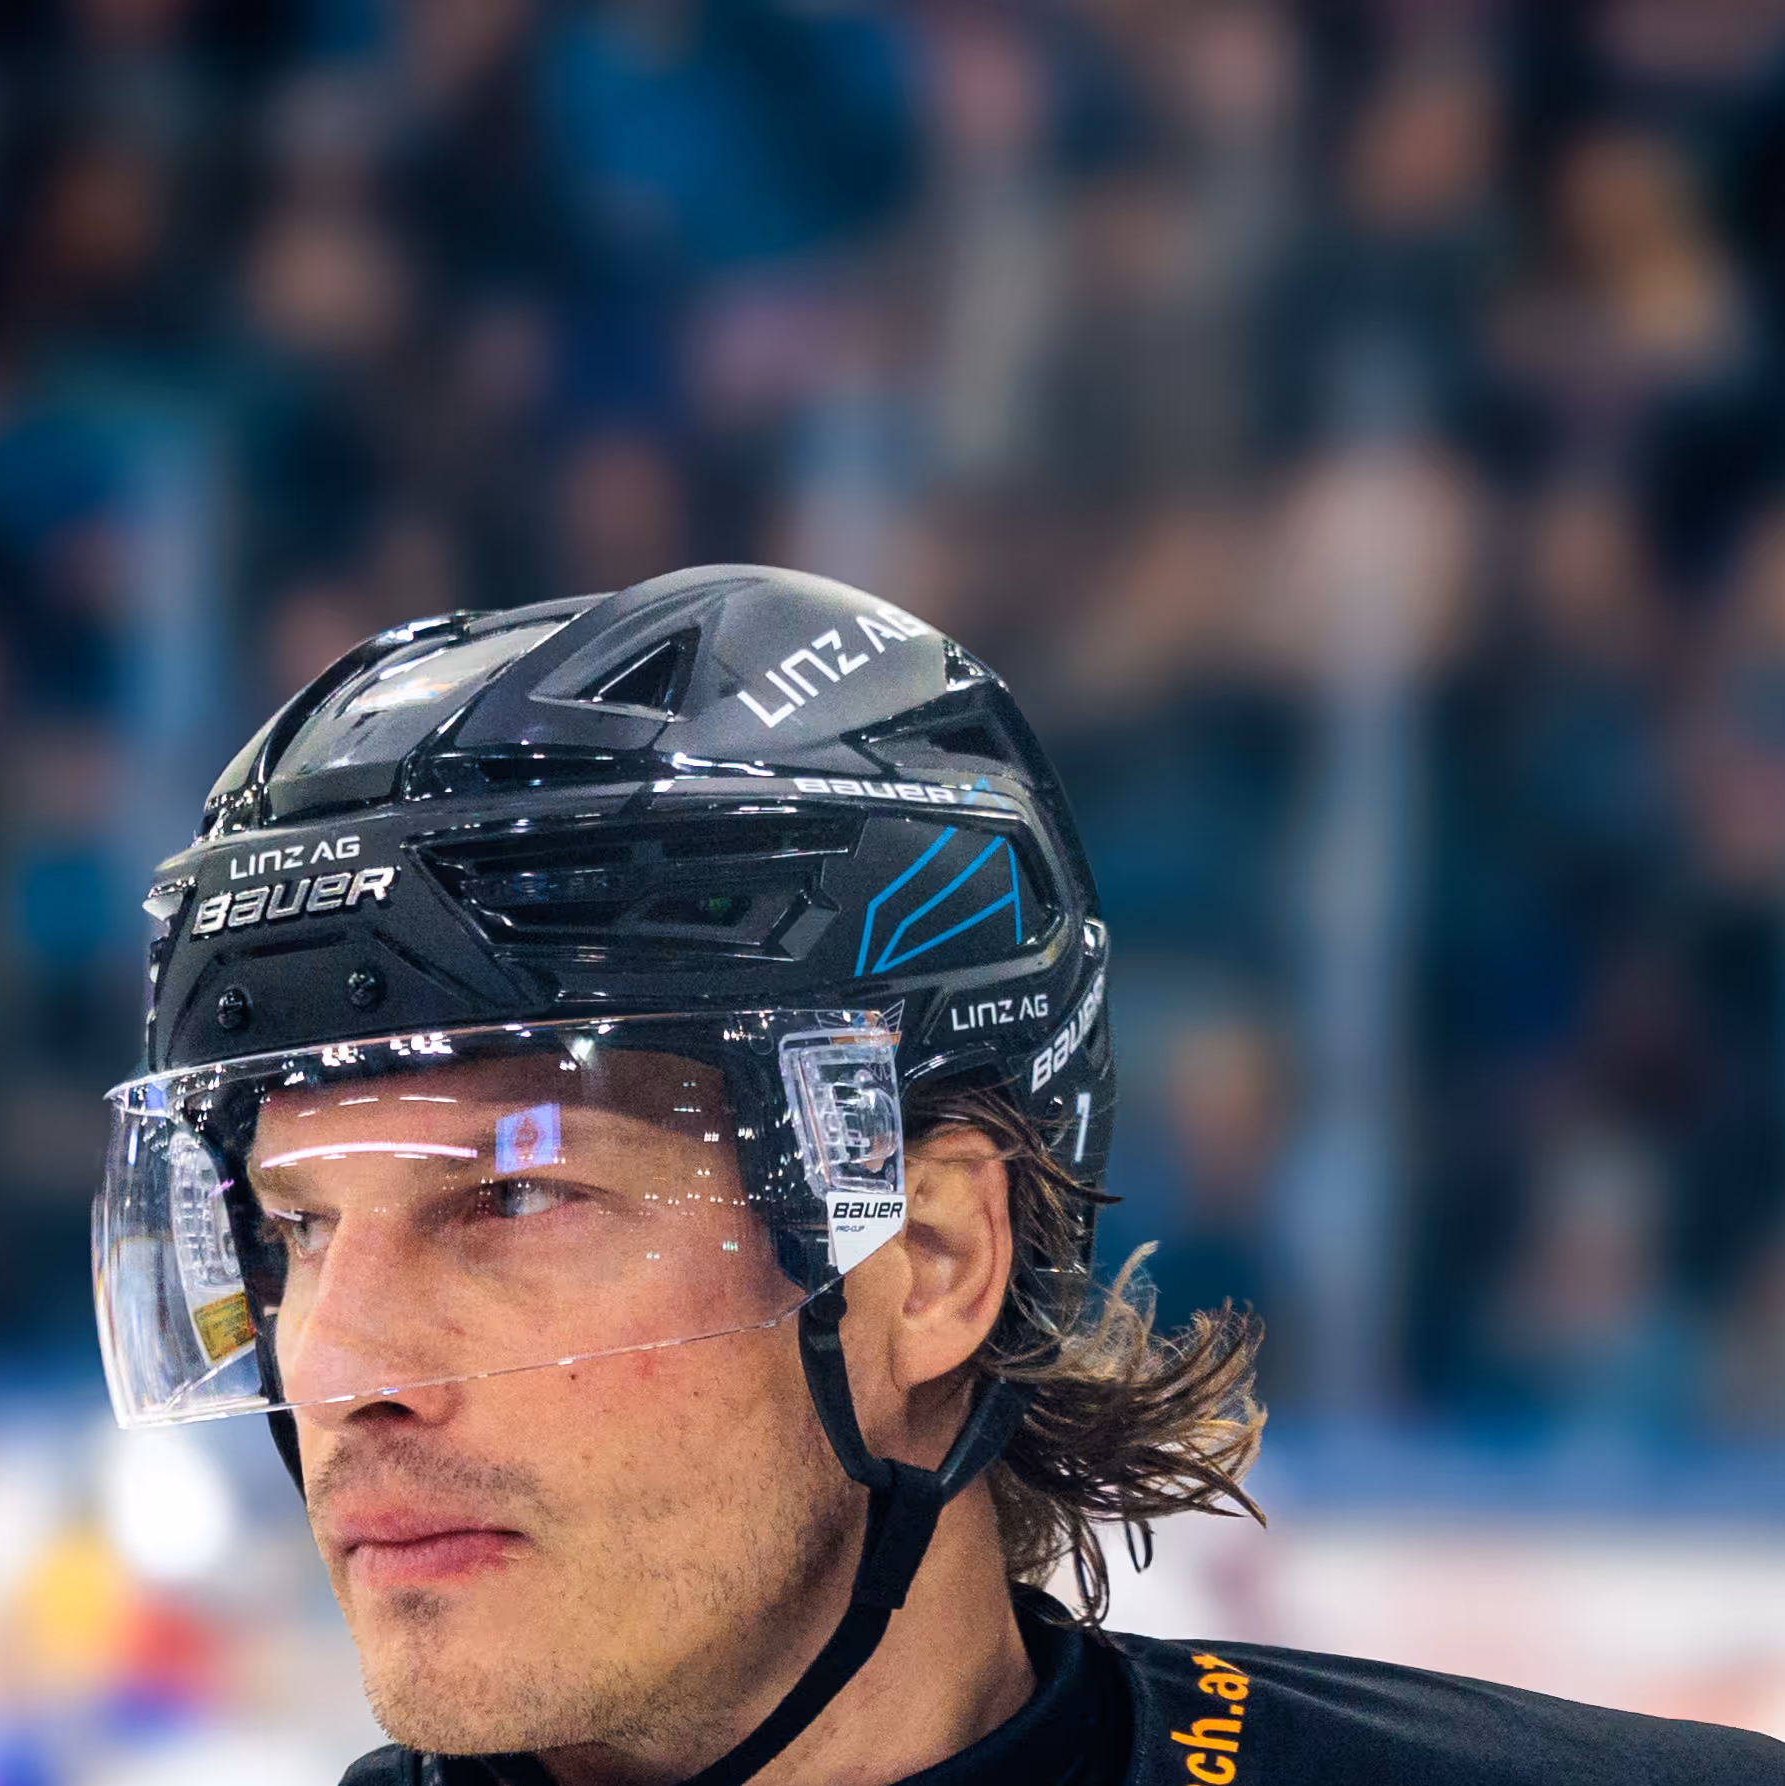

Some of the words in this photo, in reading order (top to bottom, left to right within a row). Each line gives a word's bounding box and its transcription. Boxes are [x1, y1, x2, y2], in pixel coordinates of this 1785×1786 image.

[737, 628, 870, 729] LINZ
[856, 607, 928, 654] AG
[794, 777, 956, 804] BAUER
[230, 845, 305, 881] LINZ
[310, 835, 361, 864] AG
[191, 866, 397, 936] BAUER
[951, 999, 1015, 1031] LINZ
[1019, 994, 1049, 1021] AG
[832, 1202, 904, 1219] BAUER
